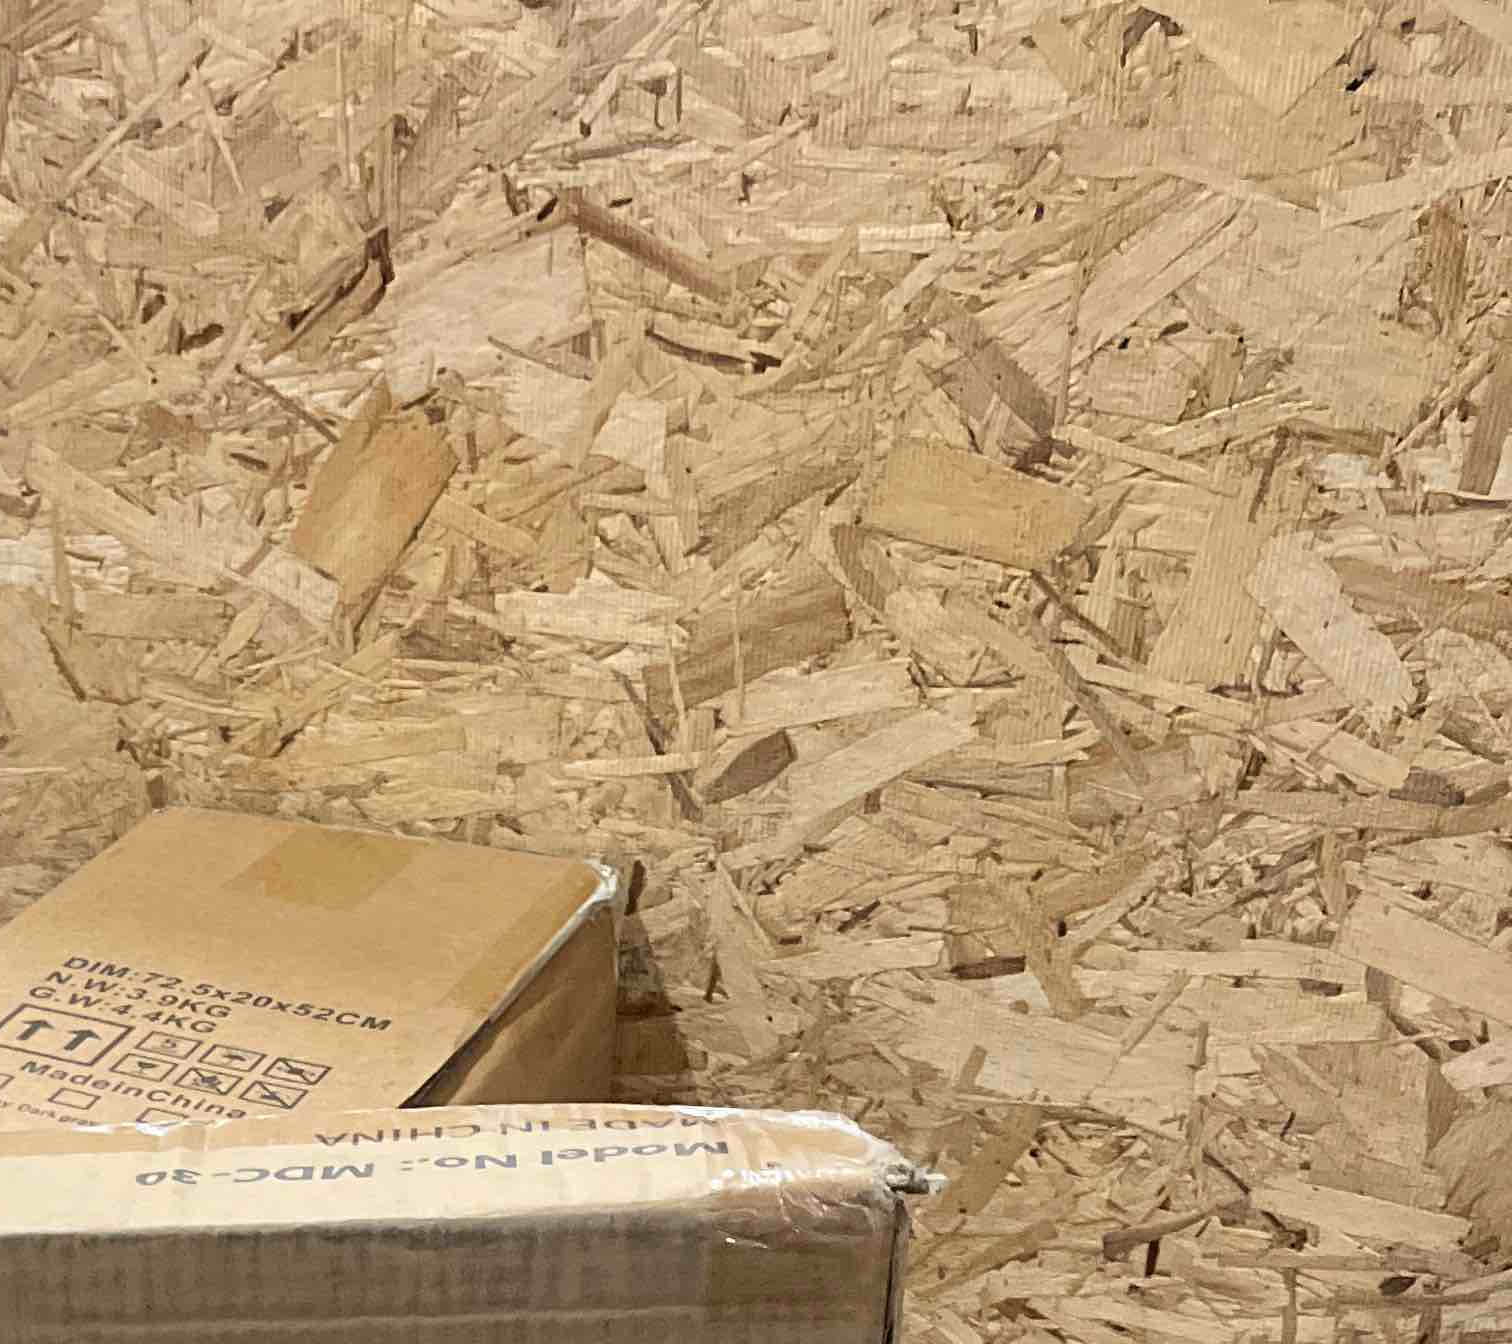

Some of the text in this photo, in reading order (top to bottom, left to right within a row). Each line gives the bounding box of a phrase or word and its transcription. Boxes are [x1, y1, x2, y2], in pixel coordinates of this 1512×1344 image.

[63, 957, 391, 1031] DIM:72.5x20x52CM
[315, 1124, 481, 1147] CHINA
[500, 1119, 550, 1136] IN
[541, 1141, 729, 1165] Model
[136, 1163, 376, 1186] MDC-30
